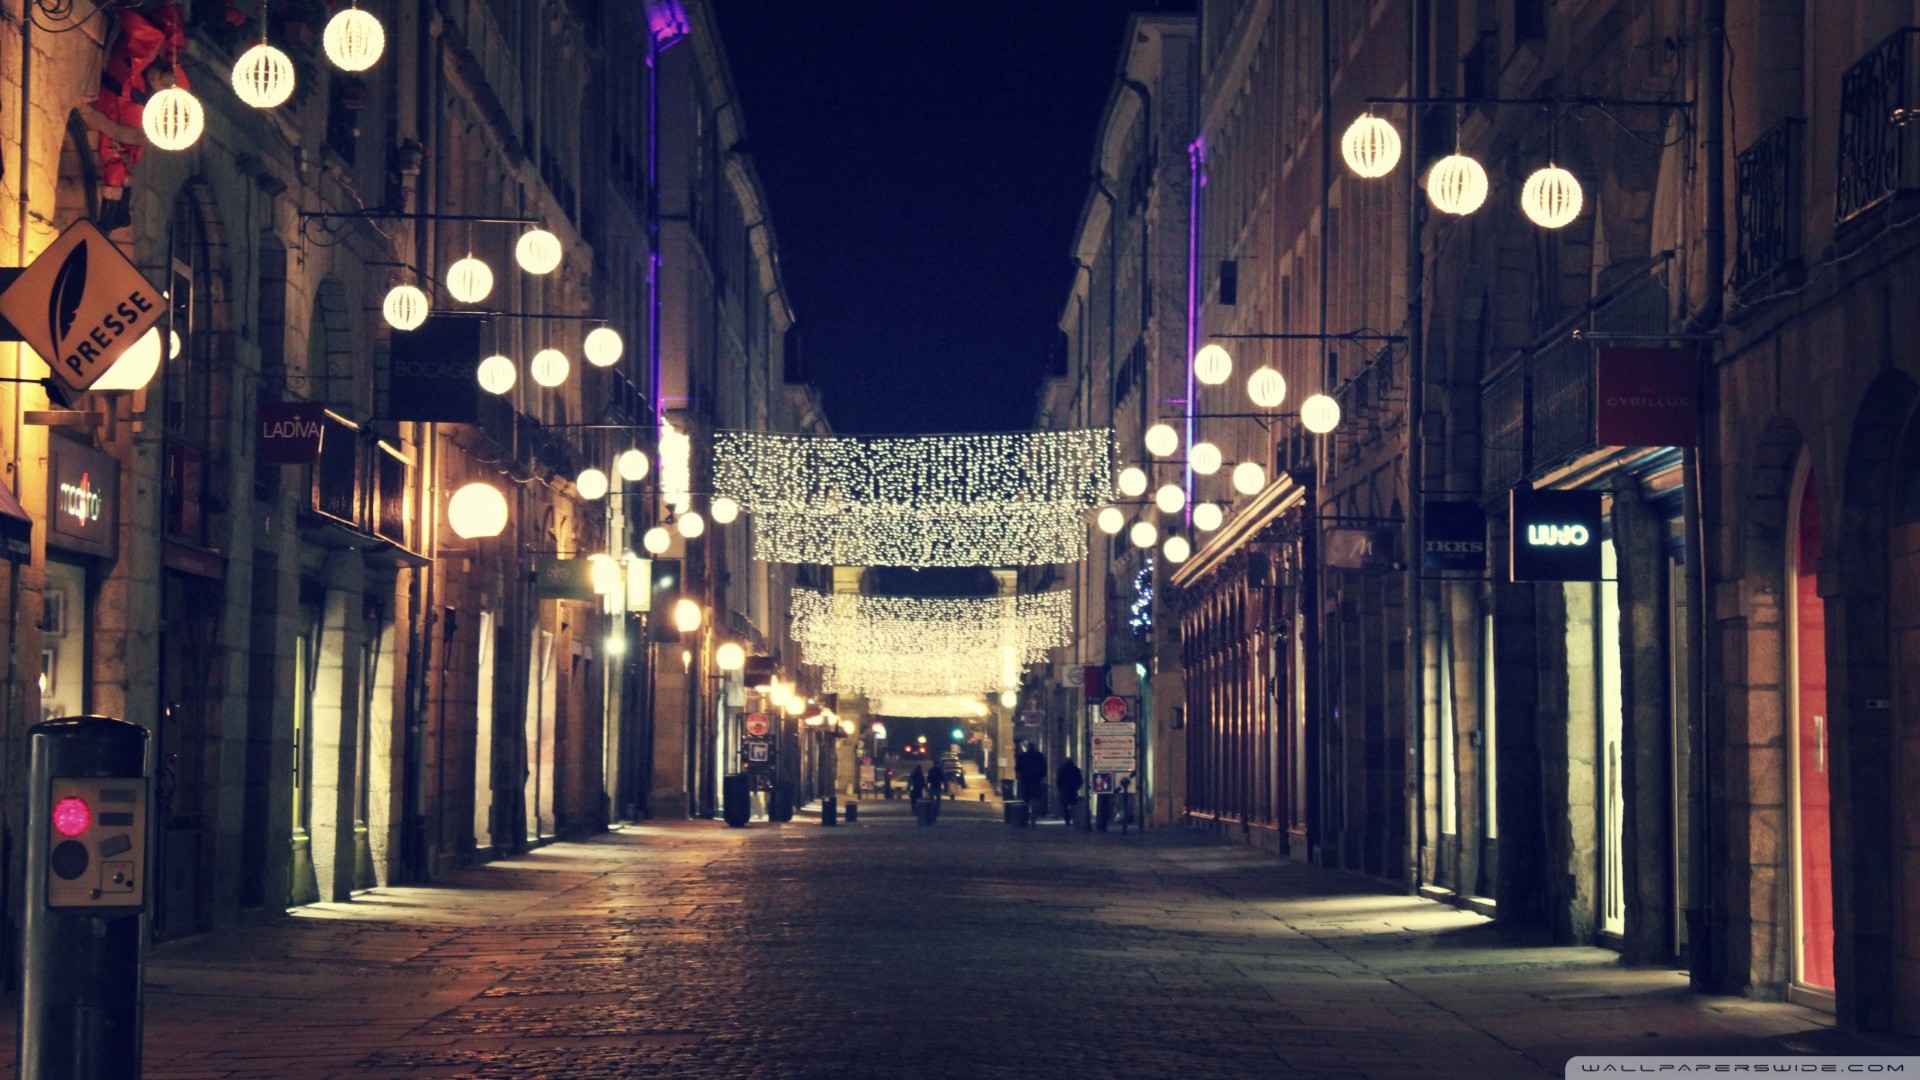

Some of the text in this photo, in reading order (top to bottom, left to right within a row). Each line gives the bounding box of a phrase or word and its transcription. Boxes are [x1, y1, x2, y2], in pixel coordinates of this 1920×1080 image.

[65, 290, 154, 378] PRESSE
[394, 360, 474, 379] BOCAGE
[1606, 396, 1690, 408] CYRILLUS
[263, 421, 320, 439] LADIVA
[1425, 540, 1484, 553] IKKS
